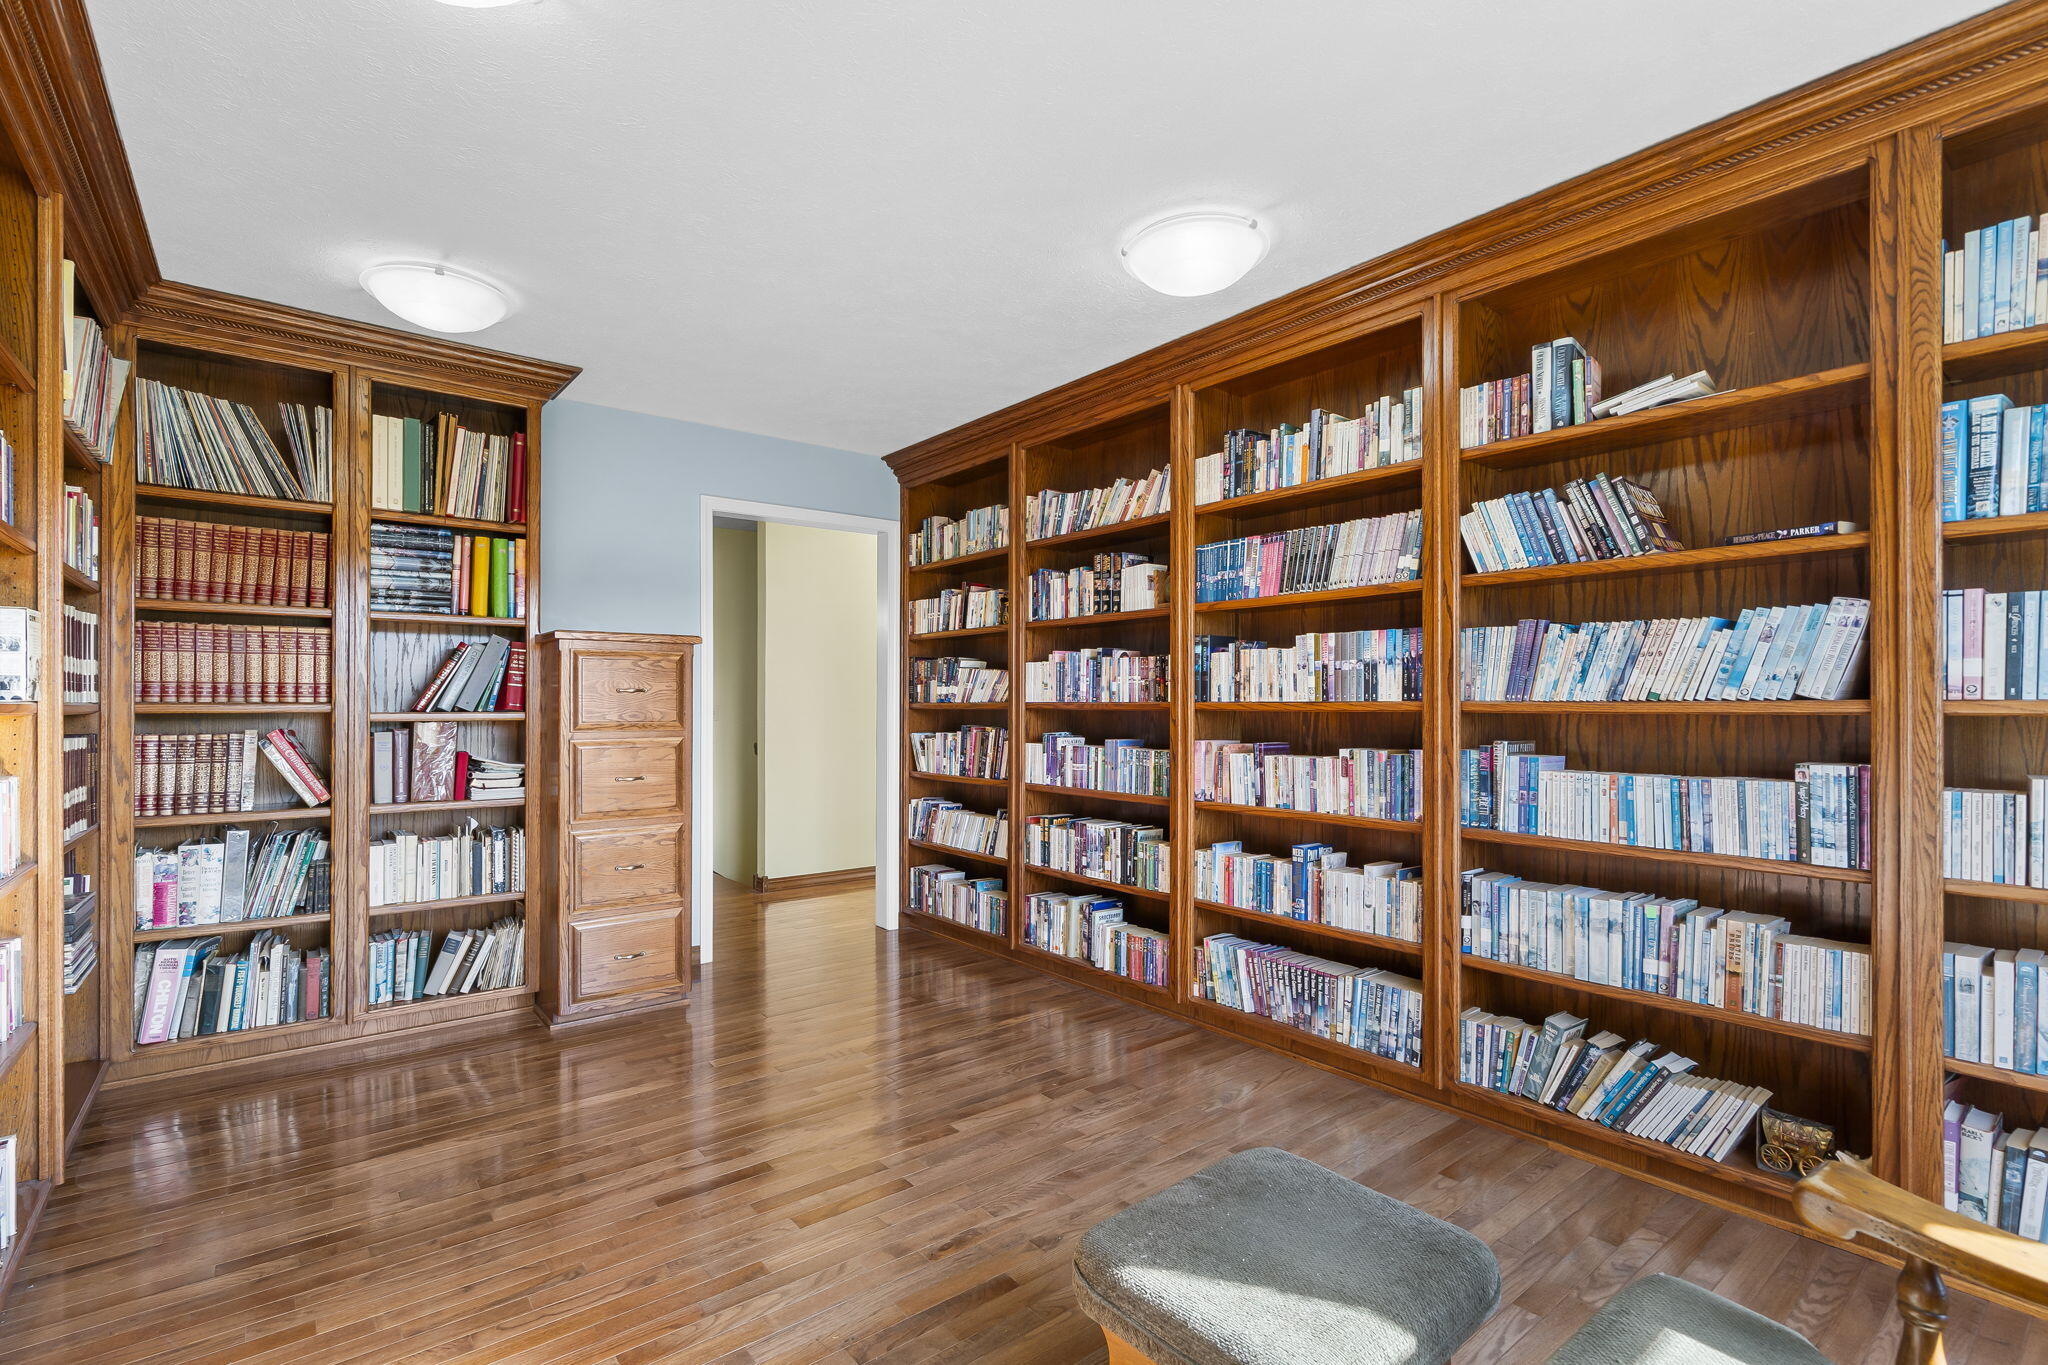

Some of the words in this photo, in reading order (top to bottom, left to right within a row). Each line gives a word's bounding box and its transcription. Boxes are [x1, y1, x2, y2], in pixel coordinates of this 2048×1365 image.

[1984, 229, 1994, 246] With
[1536, 351, 1544, 369] OLIVER
[1557, 346, 1565, 365] OLIVER
[1536, 370, 1544, 390] NORTH
[1556, 366, 1564, 385] NORTH
[1789, 525, 1820, 536] PARKER
[1551, 533, 1562, 553] PALMER
[283, 747, 315, 782] Christmas
[1479, 796, 1488, 815] PERETTI
[1798, 802, 1808, 818] Mercy
[147, 977, 173, 1036] CHILTON
